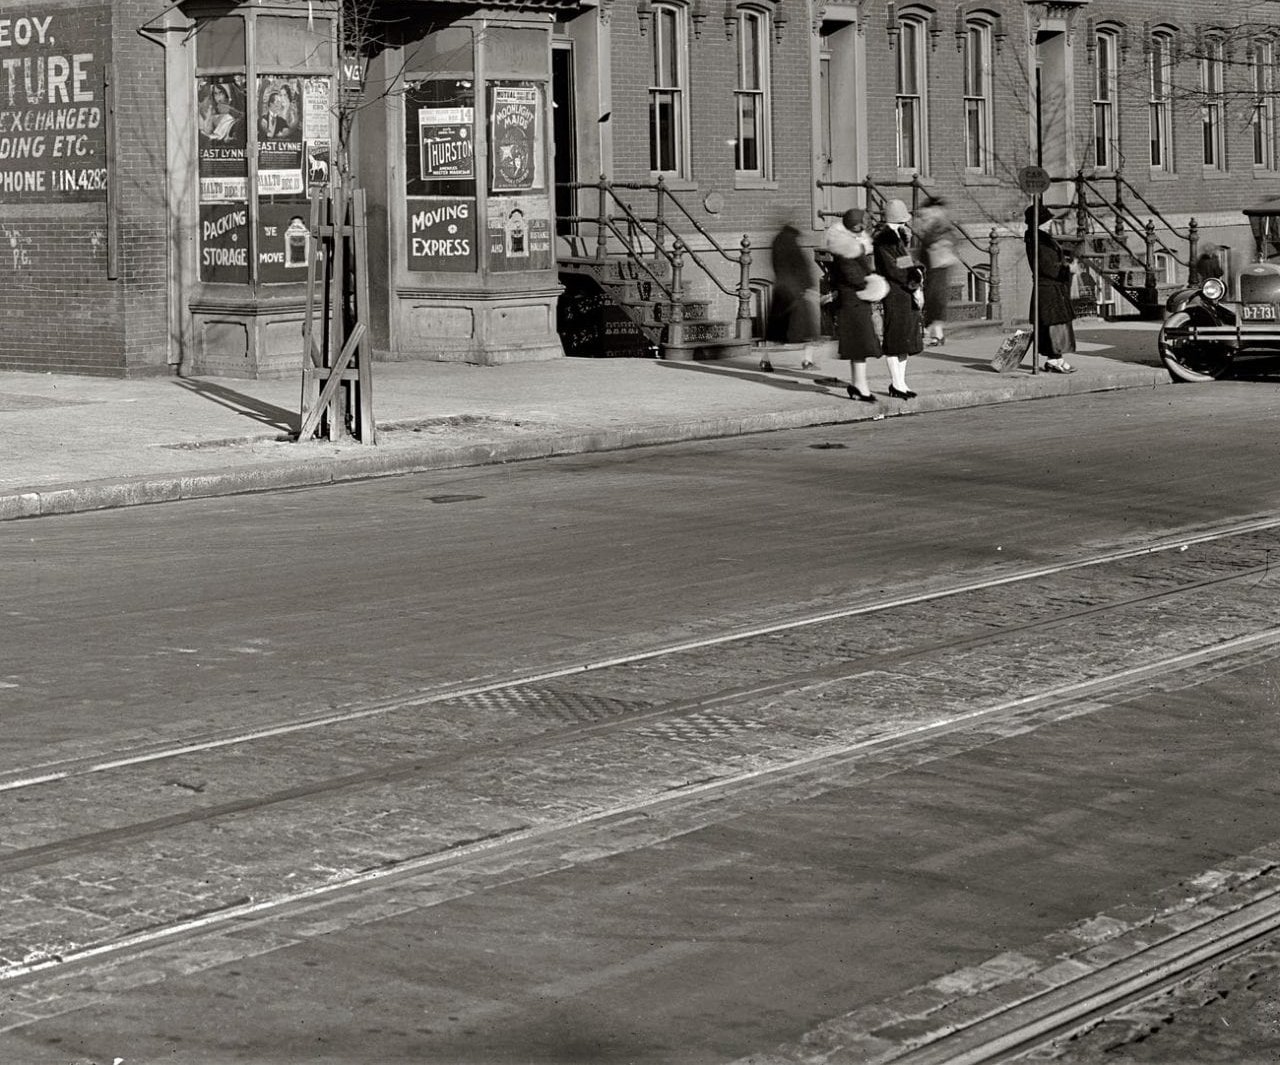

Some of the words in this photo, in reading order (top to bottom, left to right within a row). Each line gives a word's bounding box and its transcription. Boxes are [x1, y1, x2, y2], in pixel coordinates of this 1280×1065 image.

[0, 107, 101, 133] EXCHANGED
[497, 104, 535, 125] MOONLIGHT
[504, 114, 529, 130] MAIDS
[53, 134, 95, 157] ETC.
[222, 148, 247, 158] LYNN
[258, 141, 277, 151] EAST
[278, 142, 302, 152] LYNNE
[424, 137, 473, 173] THURSTON
[203, 210, 246, 241] PACKING
[411, 204, 469, 234] MOVING
[412, 238, 470, 256] EXPRESS
[490, 243, 504, 254] AND
[203, 248, 248, 266] STORAGE
[260, 252, 284, 263] MOVE
[1243, 306, 1276, 319] D-7-731
